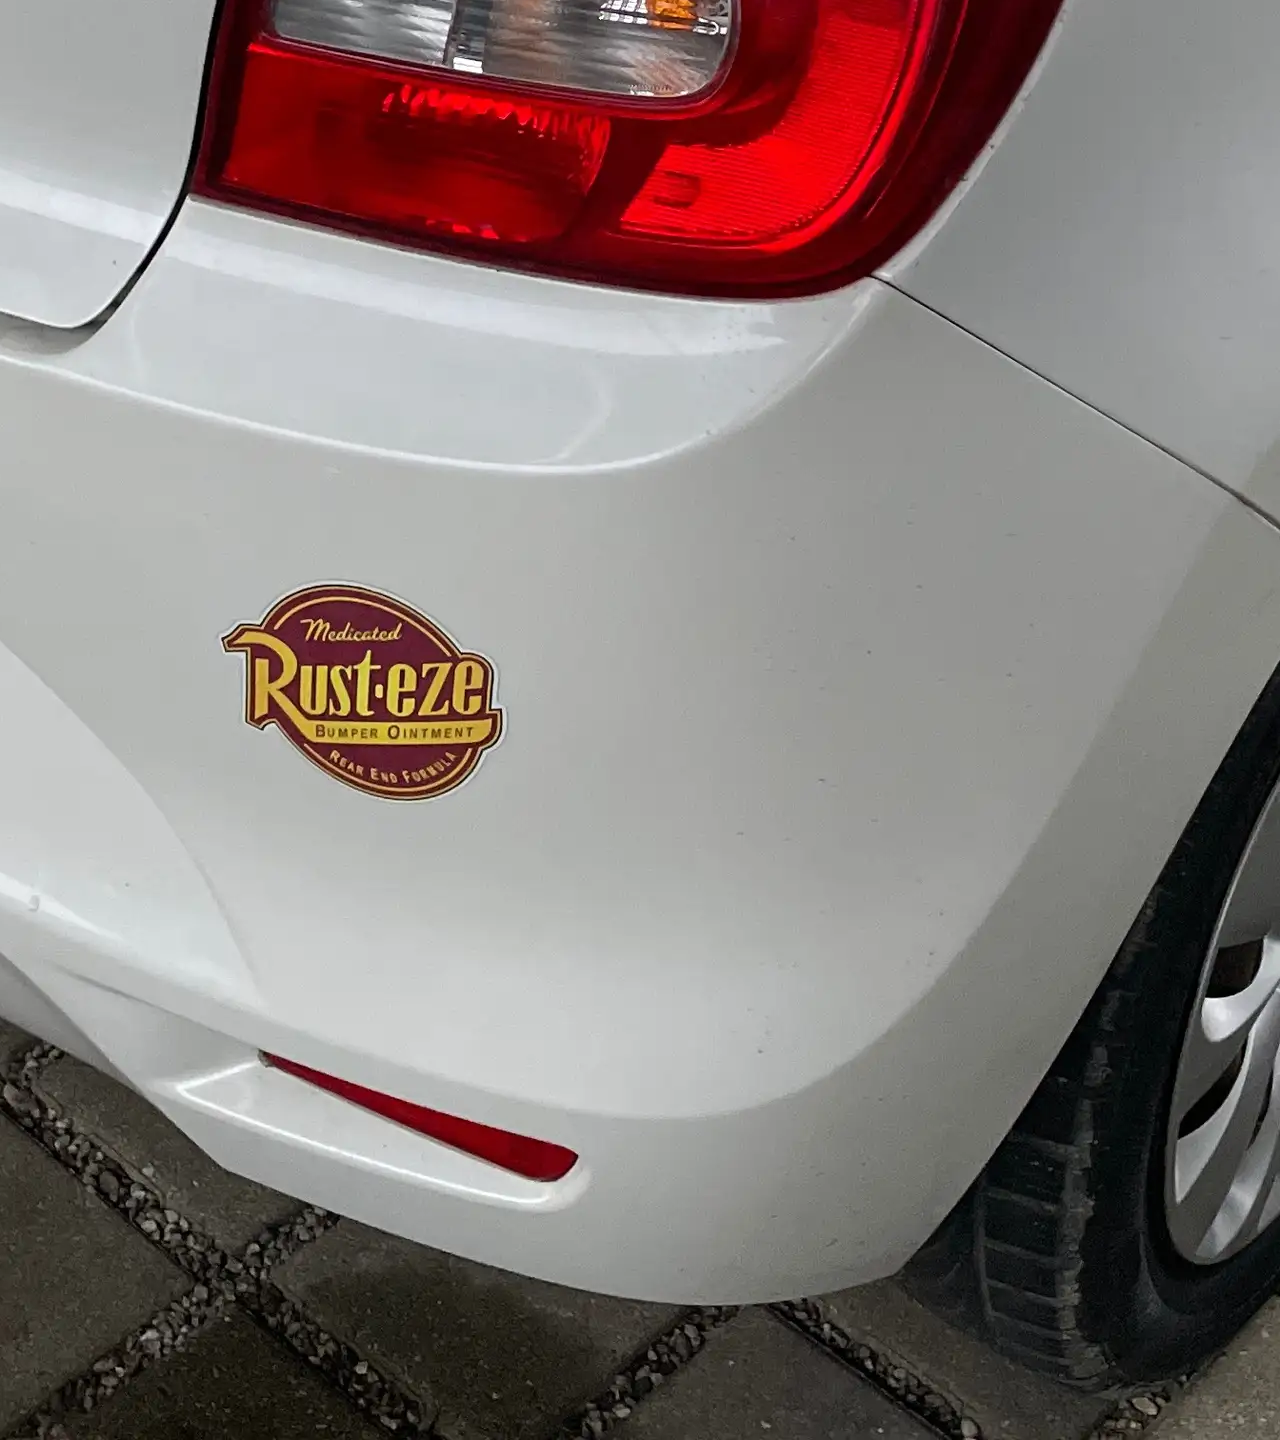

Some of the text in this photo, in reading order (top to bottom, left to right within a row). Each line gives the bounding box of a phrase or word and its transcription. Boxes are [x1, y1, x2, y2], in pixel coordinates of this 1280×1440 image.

[300, 618, 403, 642] Medicated
[315, 724, 475, 740] BUMPER OINTMENT
[329, 749, 459, 785] REAR END FORMULA
